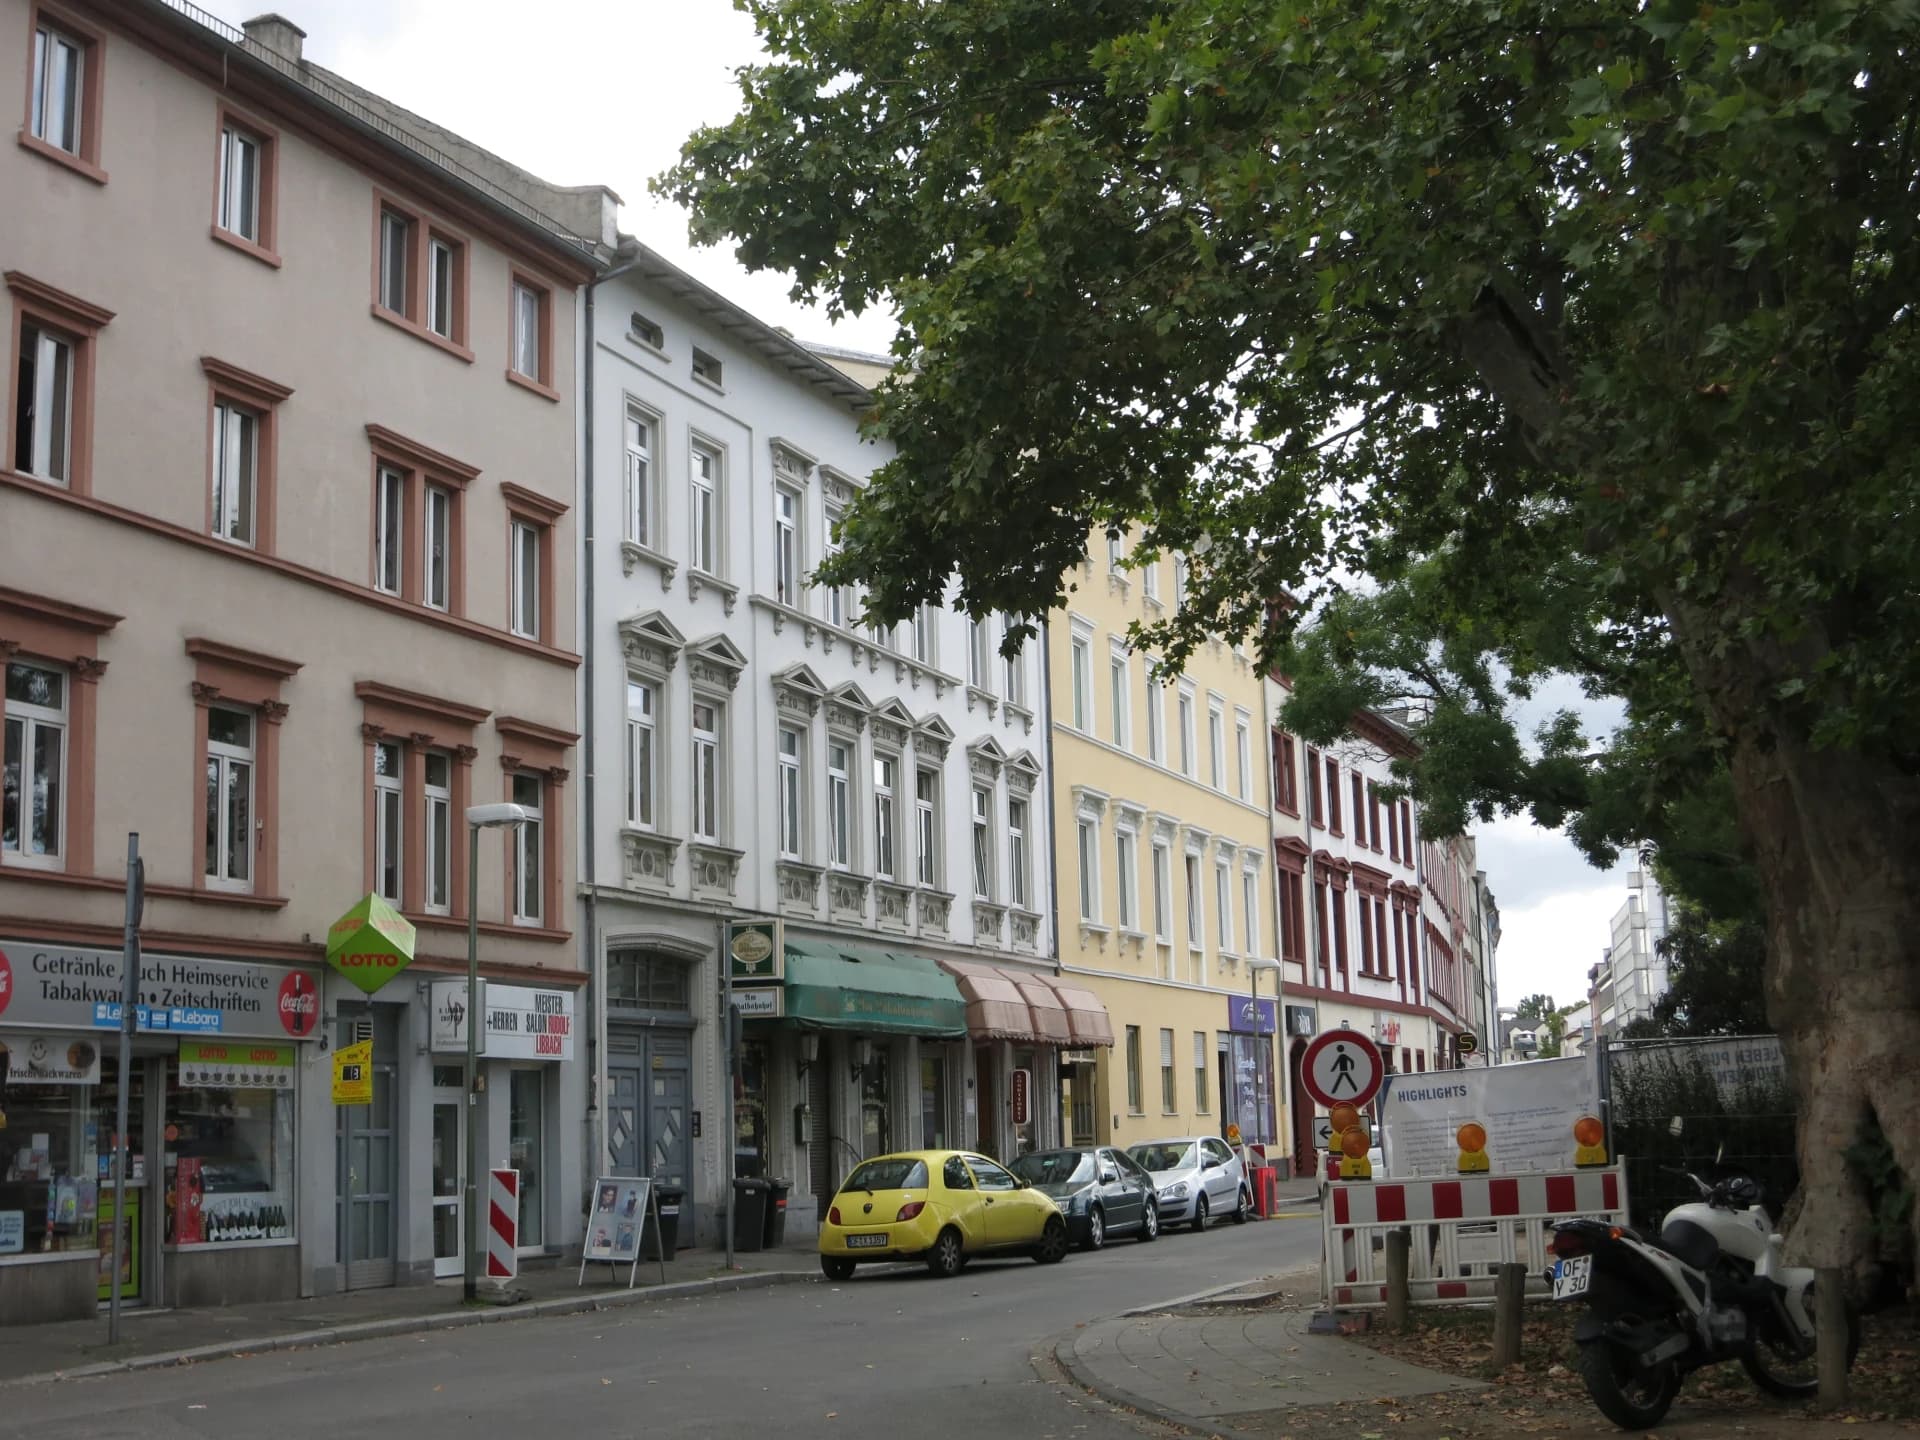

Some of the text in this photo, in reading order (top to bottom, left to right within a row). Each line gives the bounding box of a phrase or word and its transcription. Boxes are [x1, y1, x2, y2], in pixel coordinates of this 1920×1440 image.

[340, 952, 398, 967] LOTTO
[172, 965, 269, 989] Heimservice
[40, 979, 261, 1013] Tabakwarn Zeitschriften
[535, 994, 563, 1014] MEISTER
[182, 1010, 219, 1026] Lebara
[526, 1013, 546, 1033] SALON
[547, 1015, 570, 1035] RUDOLF
[536, 1035, 562, 1054] LIBBACH
[1398, 1085, 1467, 1102] HIGHLIGHTS
[1563, 1259, 1581, 1277] OF
[1556, 1275, 1587, 1296] Y 30
